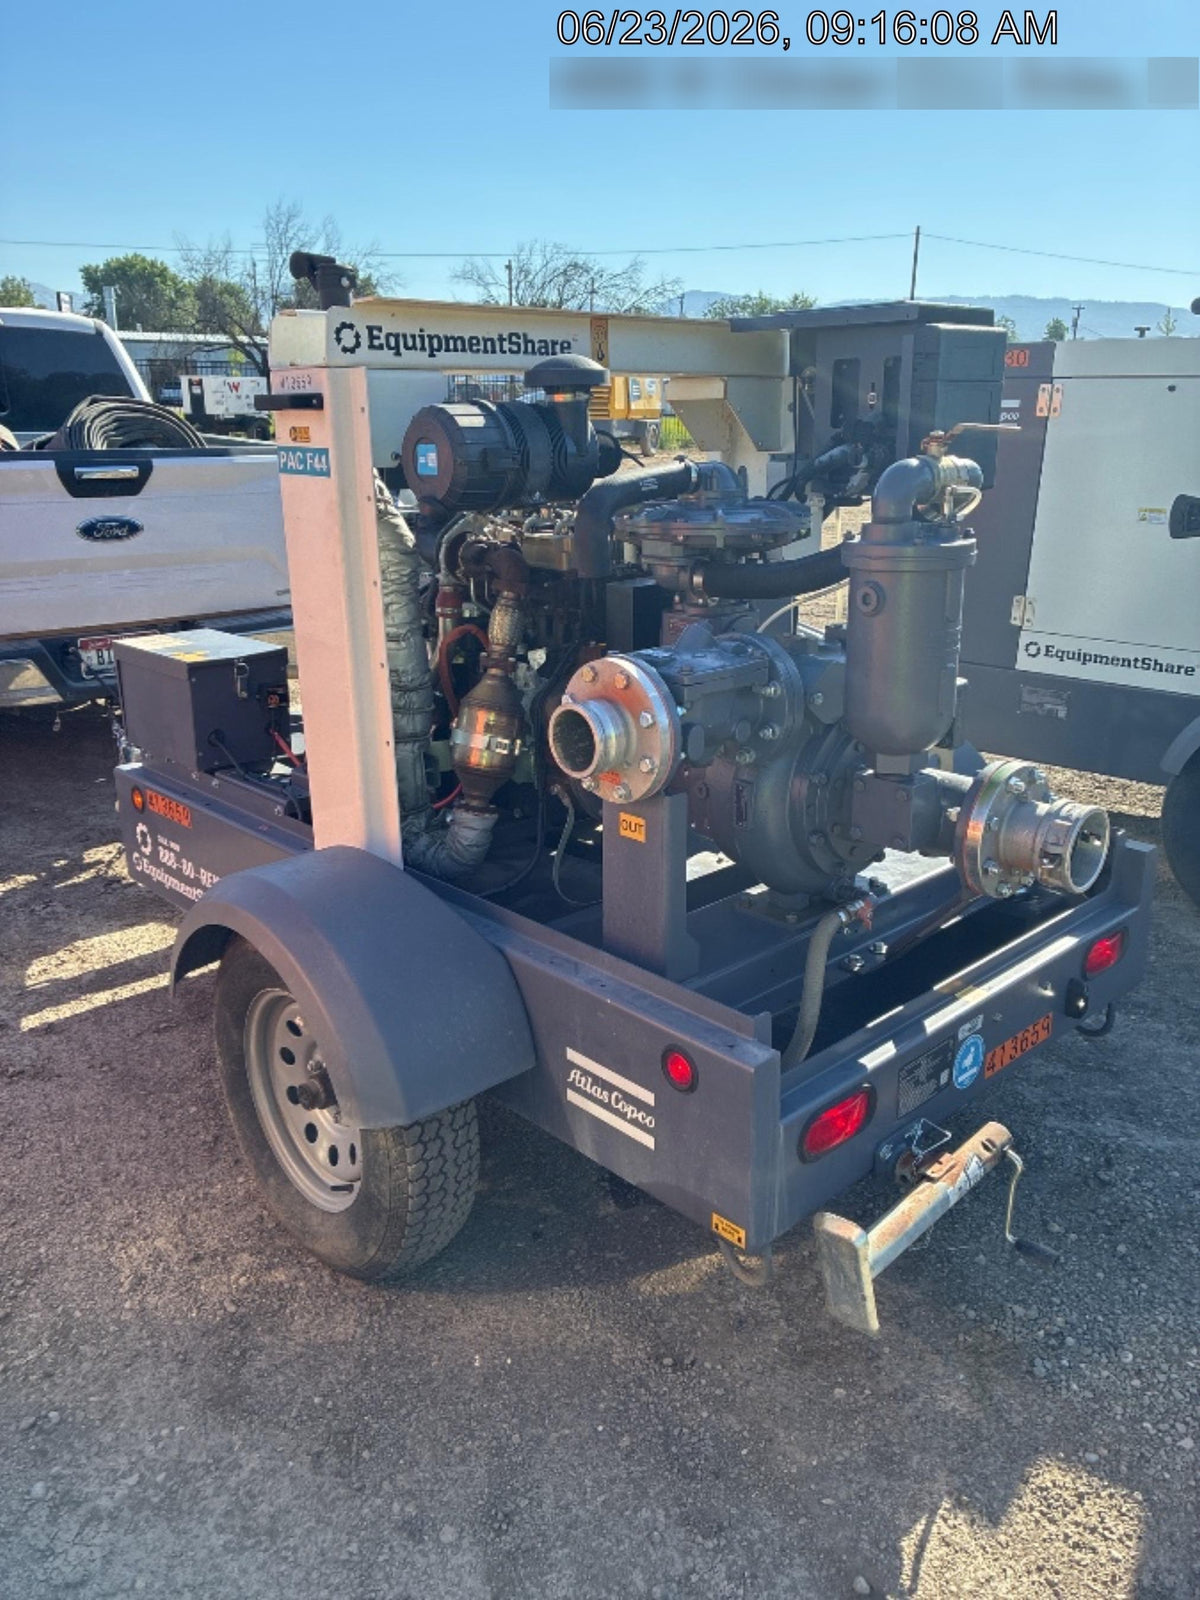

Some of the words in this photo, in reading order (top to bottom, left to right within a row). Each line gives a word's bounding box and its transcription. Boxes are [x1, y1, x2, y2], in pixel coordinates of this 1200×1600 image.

[366, 324, 572, 357] EquipmentShare
[280, 451, 304, 470] PAC
[307, 453, 328, 472] F44
[93, 521, 129, 538] Ford
[1043, 644, 1196, 677] EquipmentShare
[621, 818, 645, 835] OUT
[567, 1068, 610, 1103] Atlas
[611, 1090, 655, 1128] Copco
